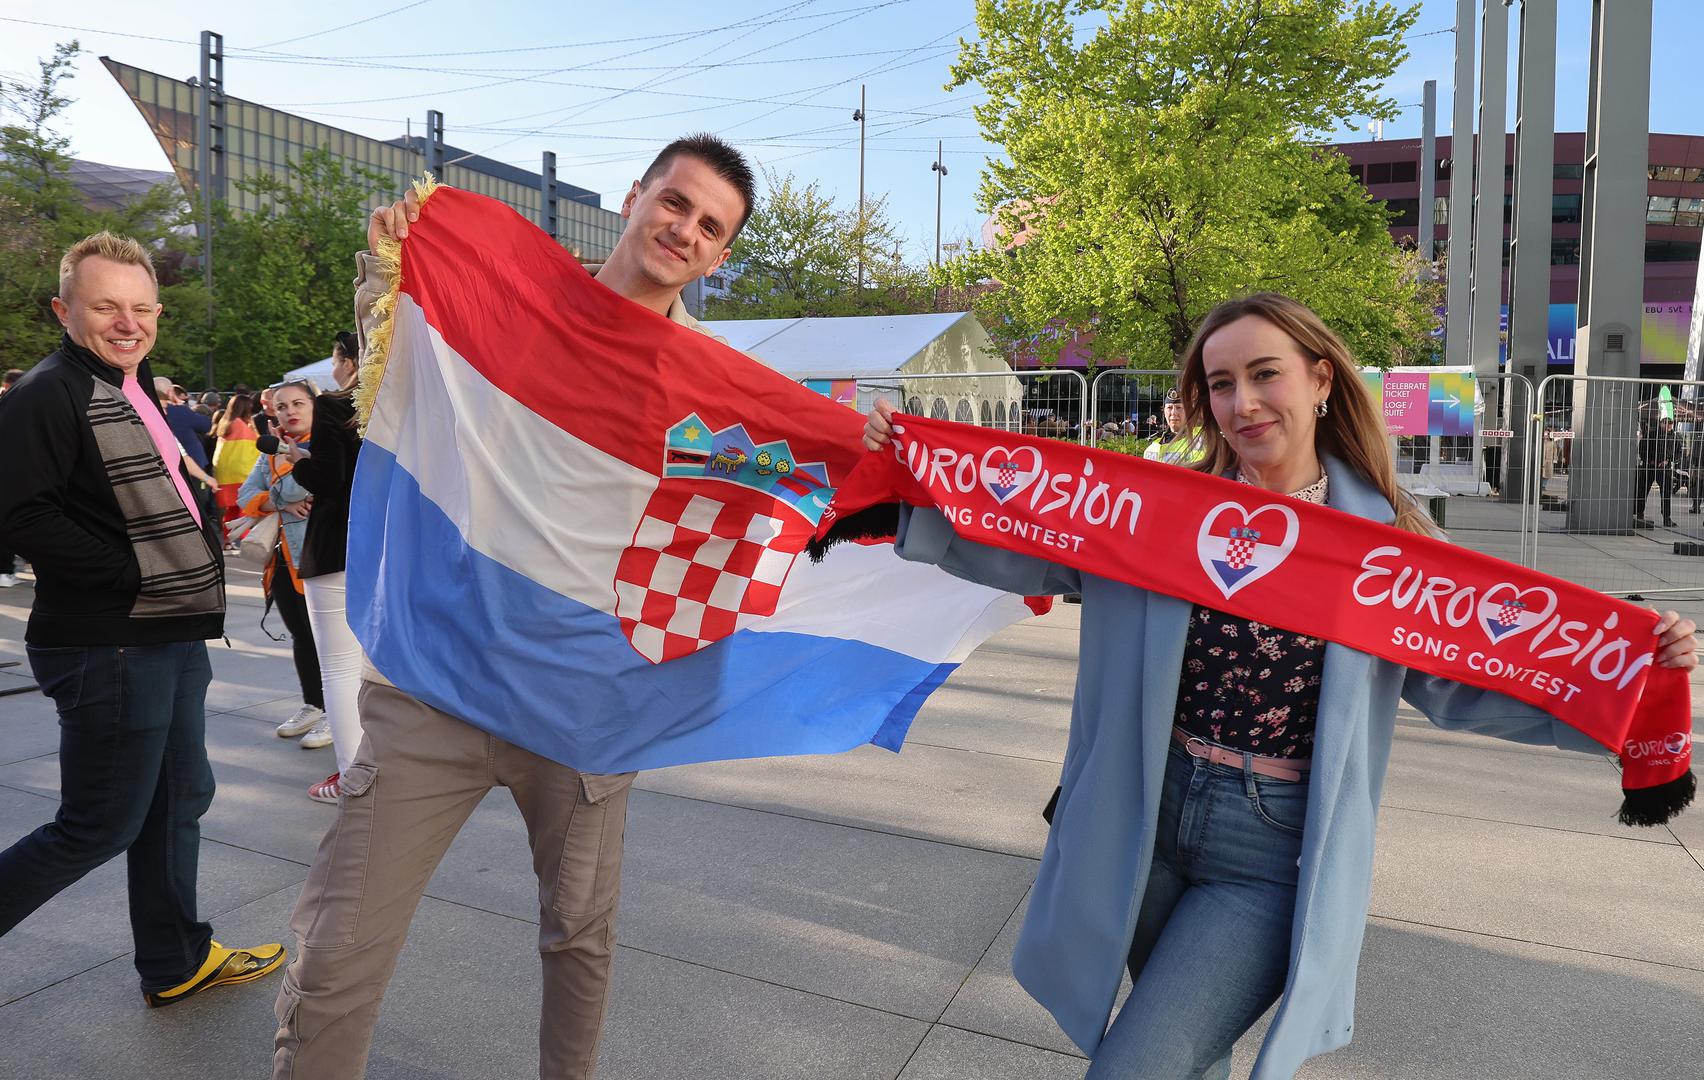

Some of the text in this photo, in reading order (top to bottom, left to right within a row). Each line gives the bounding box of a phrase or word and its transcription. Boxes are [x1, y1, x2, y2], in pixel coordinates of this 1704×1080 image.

[1646, 306, 1663, 314] EBU
[1385, 382, 1427, 390] CELEBRATE
[1385, 390, 1410, 398] TICKET
[1385, 401, 1407, 409] LOGE
[1384, 409, 1404, 417] SUITE
[981, 511, 1084, 553] CONTEST
[1391, 626, 1582, 702] SONG CONTEST
